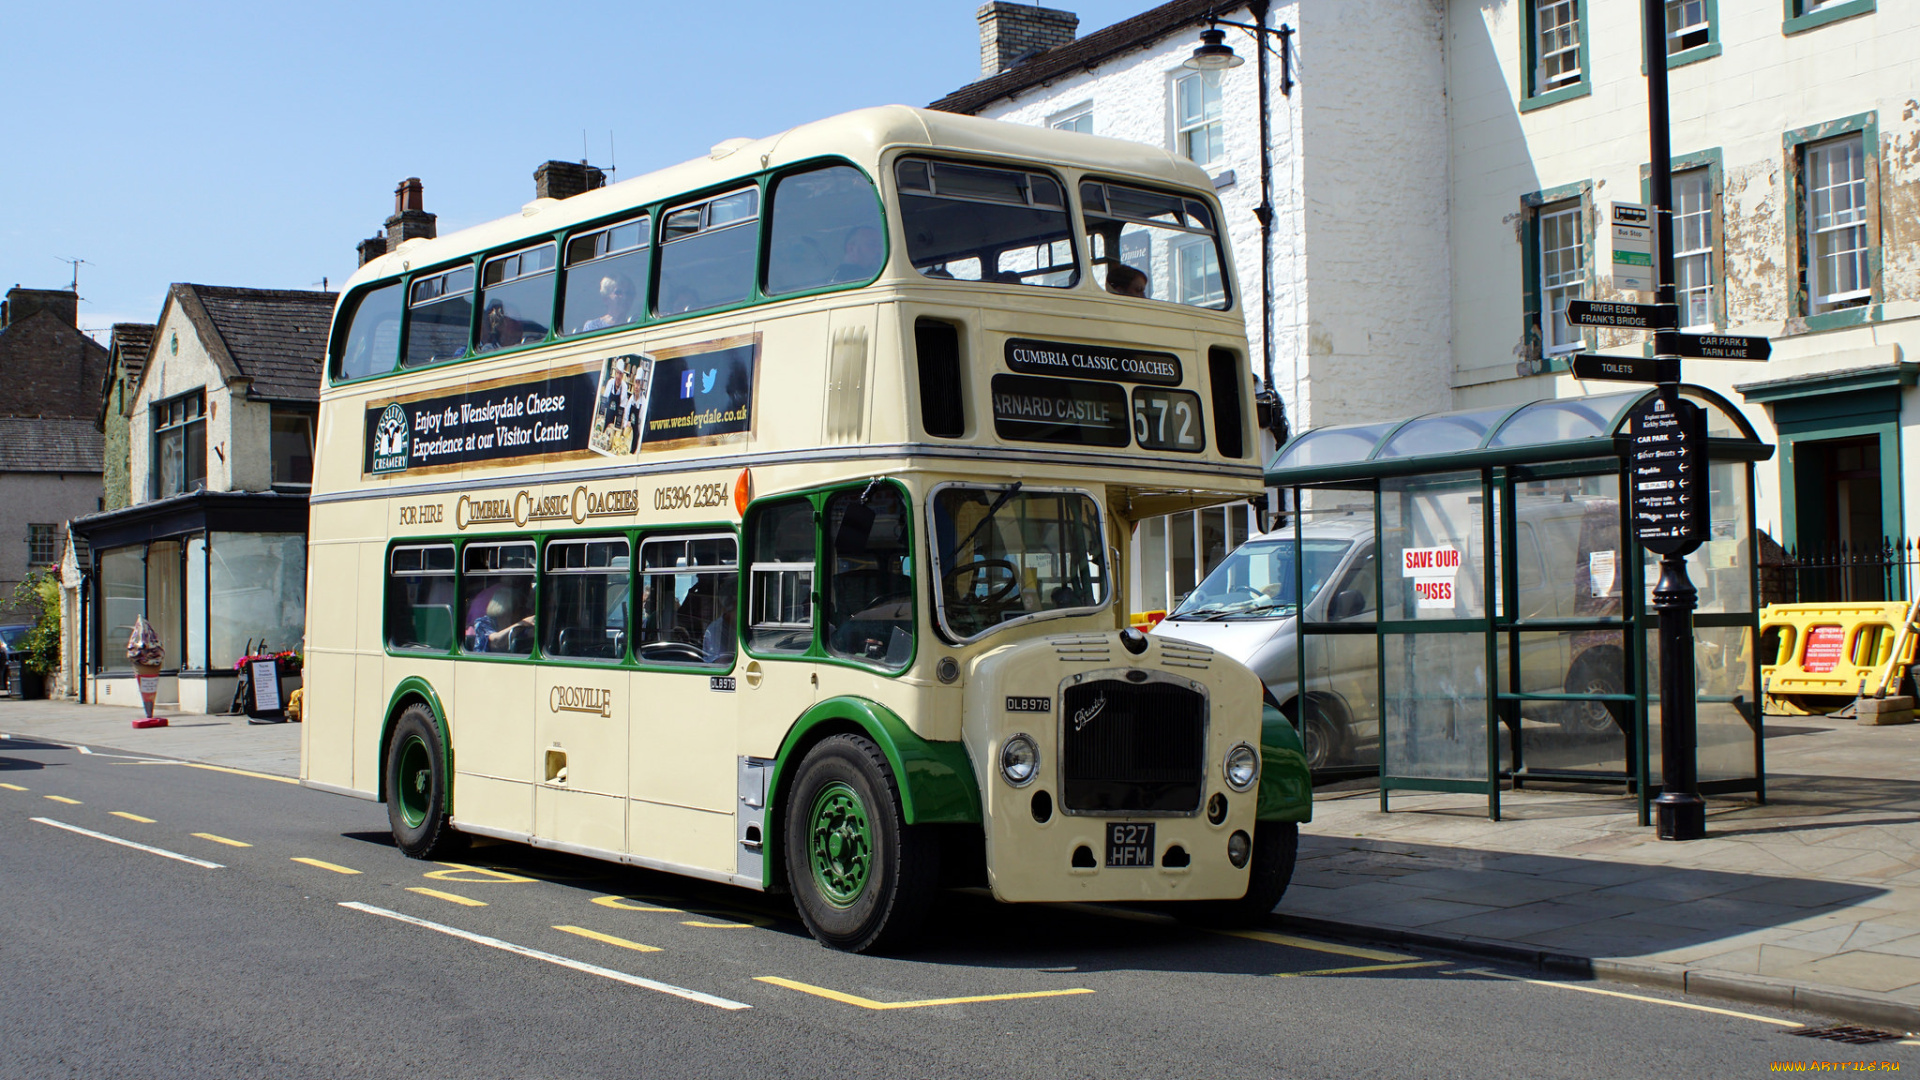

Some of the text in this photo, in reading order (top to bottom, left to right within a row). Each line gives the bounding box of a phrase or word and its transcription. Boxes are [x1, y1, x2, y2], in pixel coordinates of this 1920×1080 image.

[1618, 228, 1643, 238] Bus Stop
[1590, 303, 1637, 315] RIVER EDEN
[1581, 314, 1647, 327] FRANK'S BRIDGE
[1699, 336, 1748, 347] CAR PARK &
[1701, 347, 1748, 358] TARN LANE
[1013, 348, 1175, 377] CUMBRIA CLASSIC COACHES
[1601, 363, 1633, 374] TOILETS
[414, 392, 566, 435] Enjoy the Wensleydale Cheese
[649, 404, 748, 431] www.wensleydale.co.uk
[1056, 399, 1110, 423] CASTLE
[1135, 398, 1195, 445] 572
[412, 421, 570, 462] Experience at our Visitor Centre
[1637, 434, 1670, 444] CAR PARK
[374, 455, 407, 471] CREAMERY
[399, 482, 729, 531] FOR HIRE CUMBRIA CLASSIC COACHES 015396 23254
[1406, 549, 1459, 569] SAVE OUR
[711, 678, 736, 690] DLB978
[549, 685, 611, 719] CROSVILLE
[1007, 698, 1050, 711] DLB978
[1074, 689, 1107, 732] Bristol
[1113, 825, 1149, 845] 627
[1112, 846, 1148, 865] HFM
